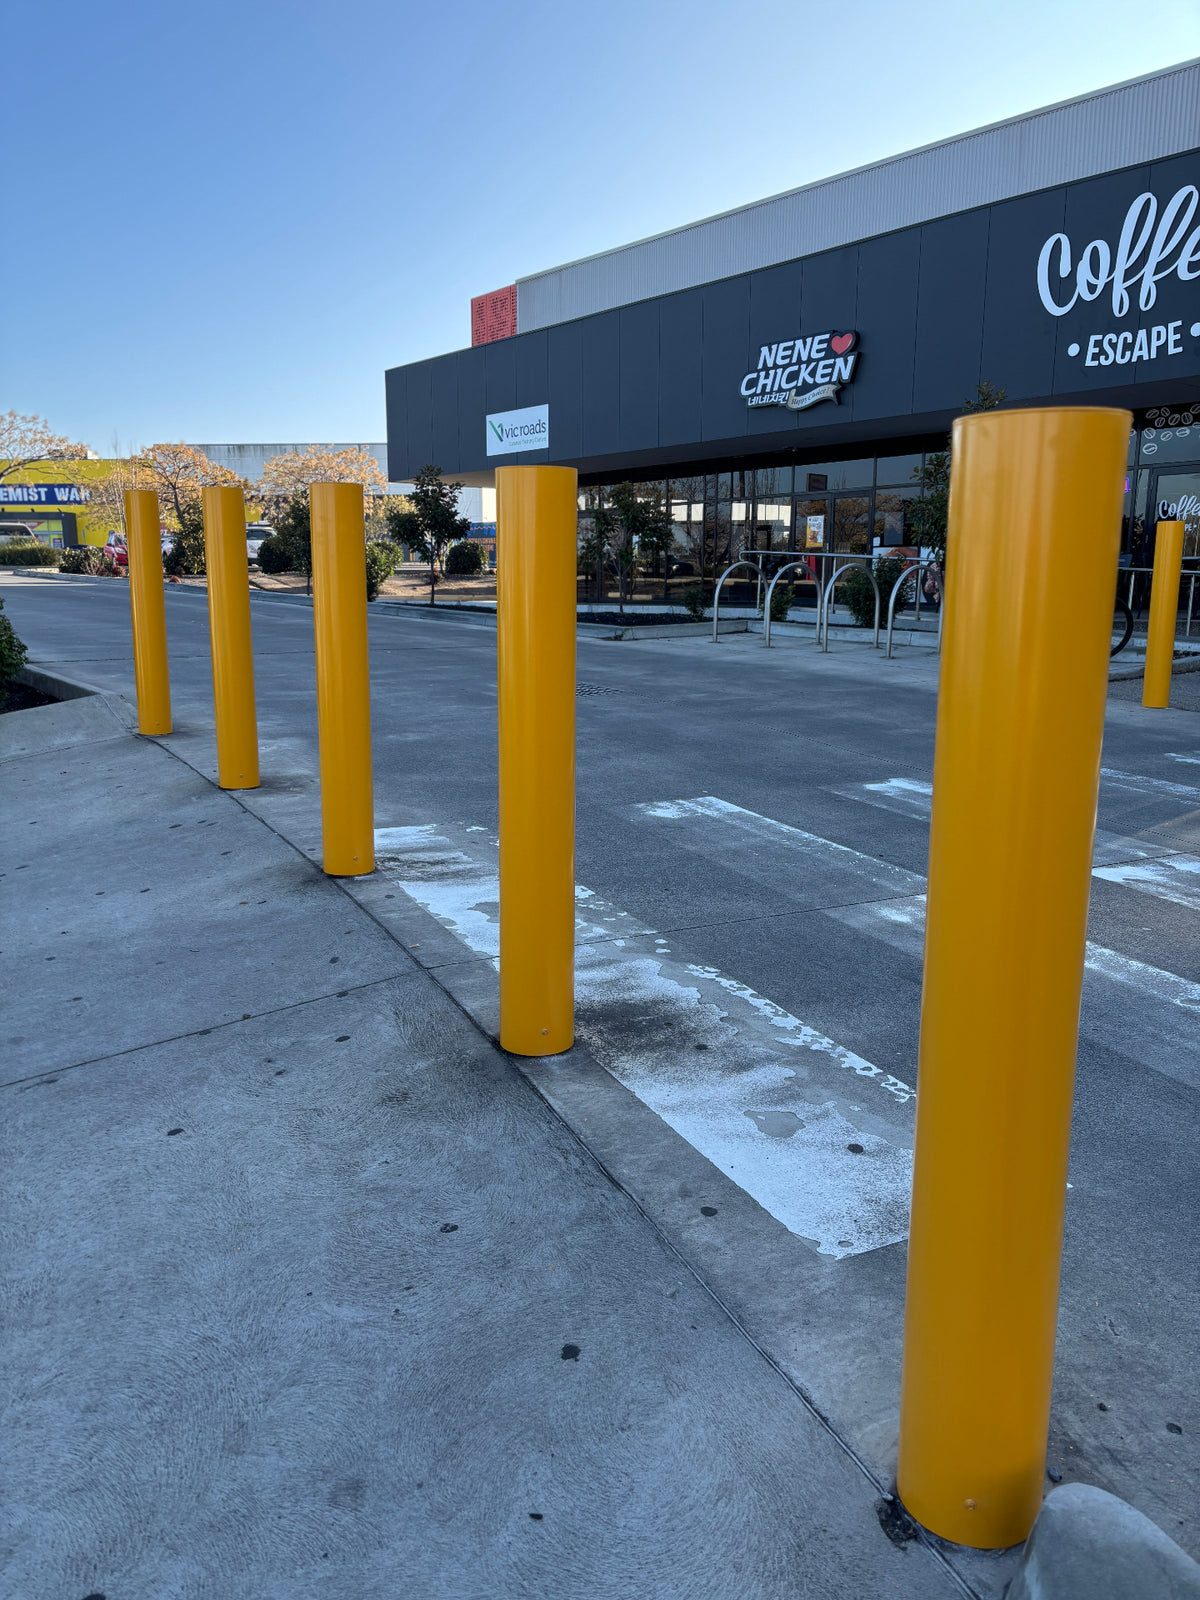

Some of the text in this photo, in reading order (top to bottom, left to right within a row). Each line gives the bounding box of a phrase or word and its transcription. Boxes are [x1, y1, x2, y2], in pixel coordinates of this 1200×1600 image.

[757, 333, 830, 369] NENE
[1085, 320, 1183, 367] ESCAPE
[740, 355, 855, 396] CHICKEN
[1159, 494, 1200, 521] Coffe
